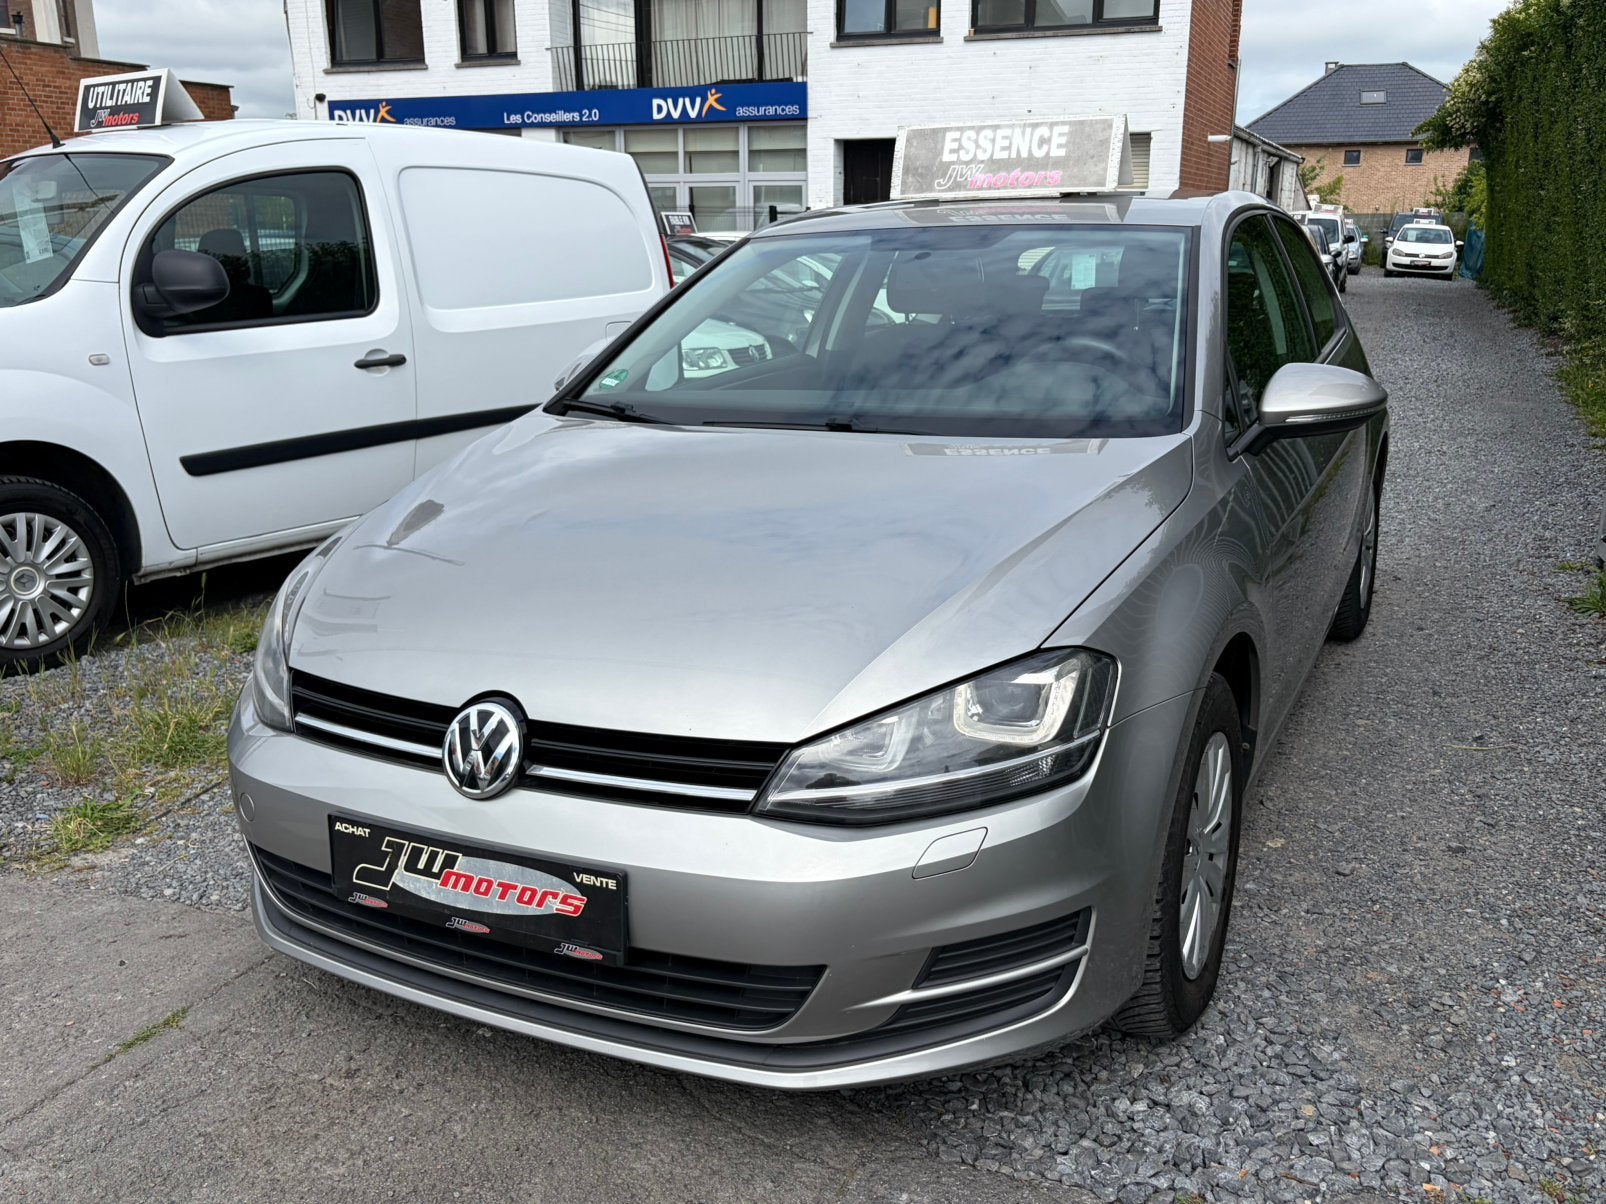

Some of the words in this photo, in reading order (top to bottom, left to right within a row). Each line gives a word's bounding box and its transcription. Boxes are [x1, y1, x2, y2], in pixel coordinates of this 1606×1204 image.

[88, 80, 153, 109] UTILITAIRE
[504, 112, 522, 124] Les
[524, 110, 580, 123] Conseillers
[582, 109, 599, 121] 2.0
[652, 97, 701, 120] DVV
[736, 103, 800, 116] assurances
[403, 115, 456, 126] assurances
[942, 125, 1070, 162] ESSENCE
[967, 168, 1063, 190] motors
[334, 821, 371, 838] ACHAT
[574, 872, 617, 890] VENTE
